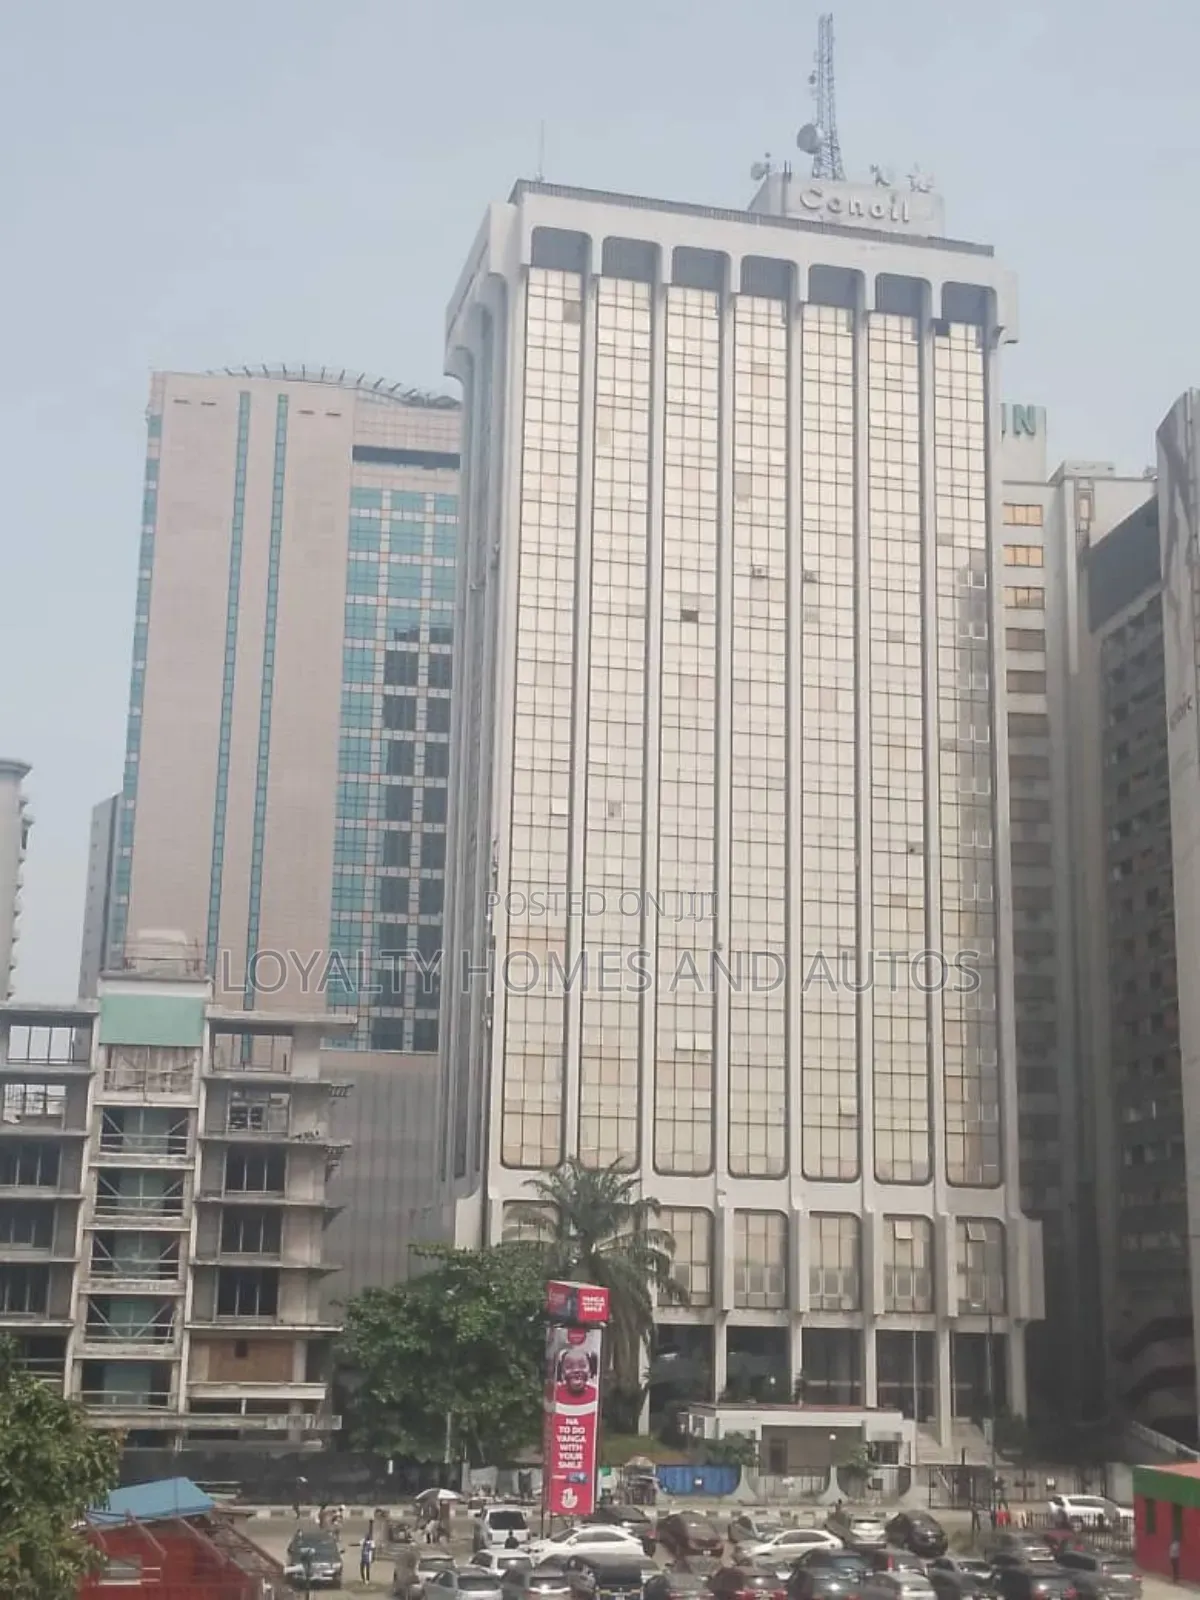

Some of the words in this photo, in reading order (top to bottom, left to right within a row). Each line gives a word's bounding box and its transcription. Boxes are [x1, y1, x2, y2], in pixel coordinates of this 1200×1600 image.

[800, 186, 911, 223] Conoil
[558, 1426, 571, 1434] TO
[559, 1443, 583, 1452] WITH
[558, 1452, 583, 1461] YOUR
[558, 1461, 582, 1469] SMILE
